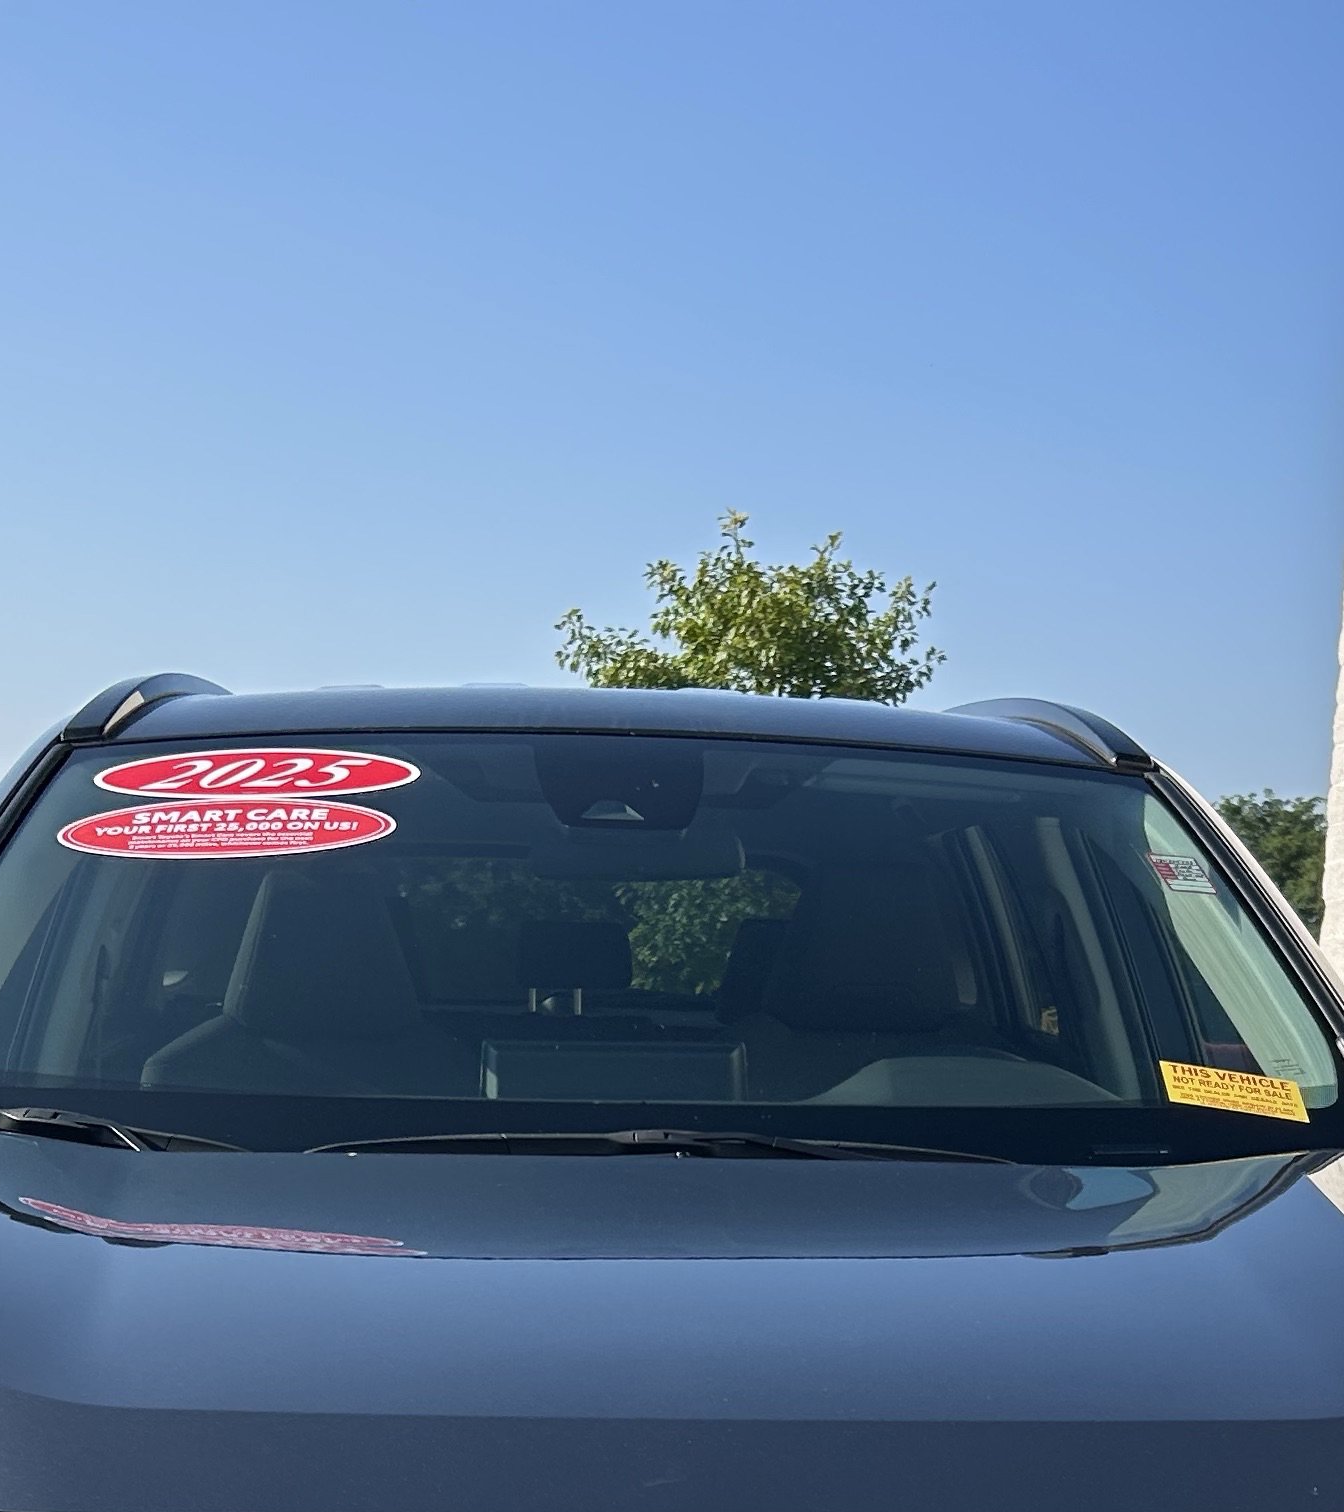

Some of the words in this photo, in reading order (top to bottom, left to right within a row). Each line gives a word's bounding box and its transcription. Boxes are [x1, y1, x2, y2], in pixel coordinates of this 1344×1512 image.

[138, 757, 373, 790] 2025
[95, 825, 152, 836] YOUR
[154, 822, 213, 834] FIRST
[213, 821, 284, 832] 25,000
[286, 821, 321, 831] ON
[323, 821, 359, 831] US!
[132, 808, 244, 825] SMART
[246, 808, 330, 821] CARE
[1168, 1064, 1212, 1079] THIS
[1214, 1070, 1292, 1091] VEHICLE
[1172, 1075, 1196, 1086] NOT
[1197, 1079, 1236, 1091] READY
[1238, 1084, 1262, 1096] FOR
[1263, 1089, 1294, 1101] SALE
